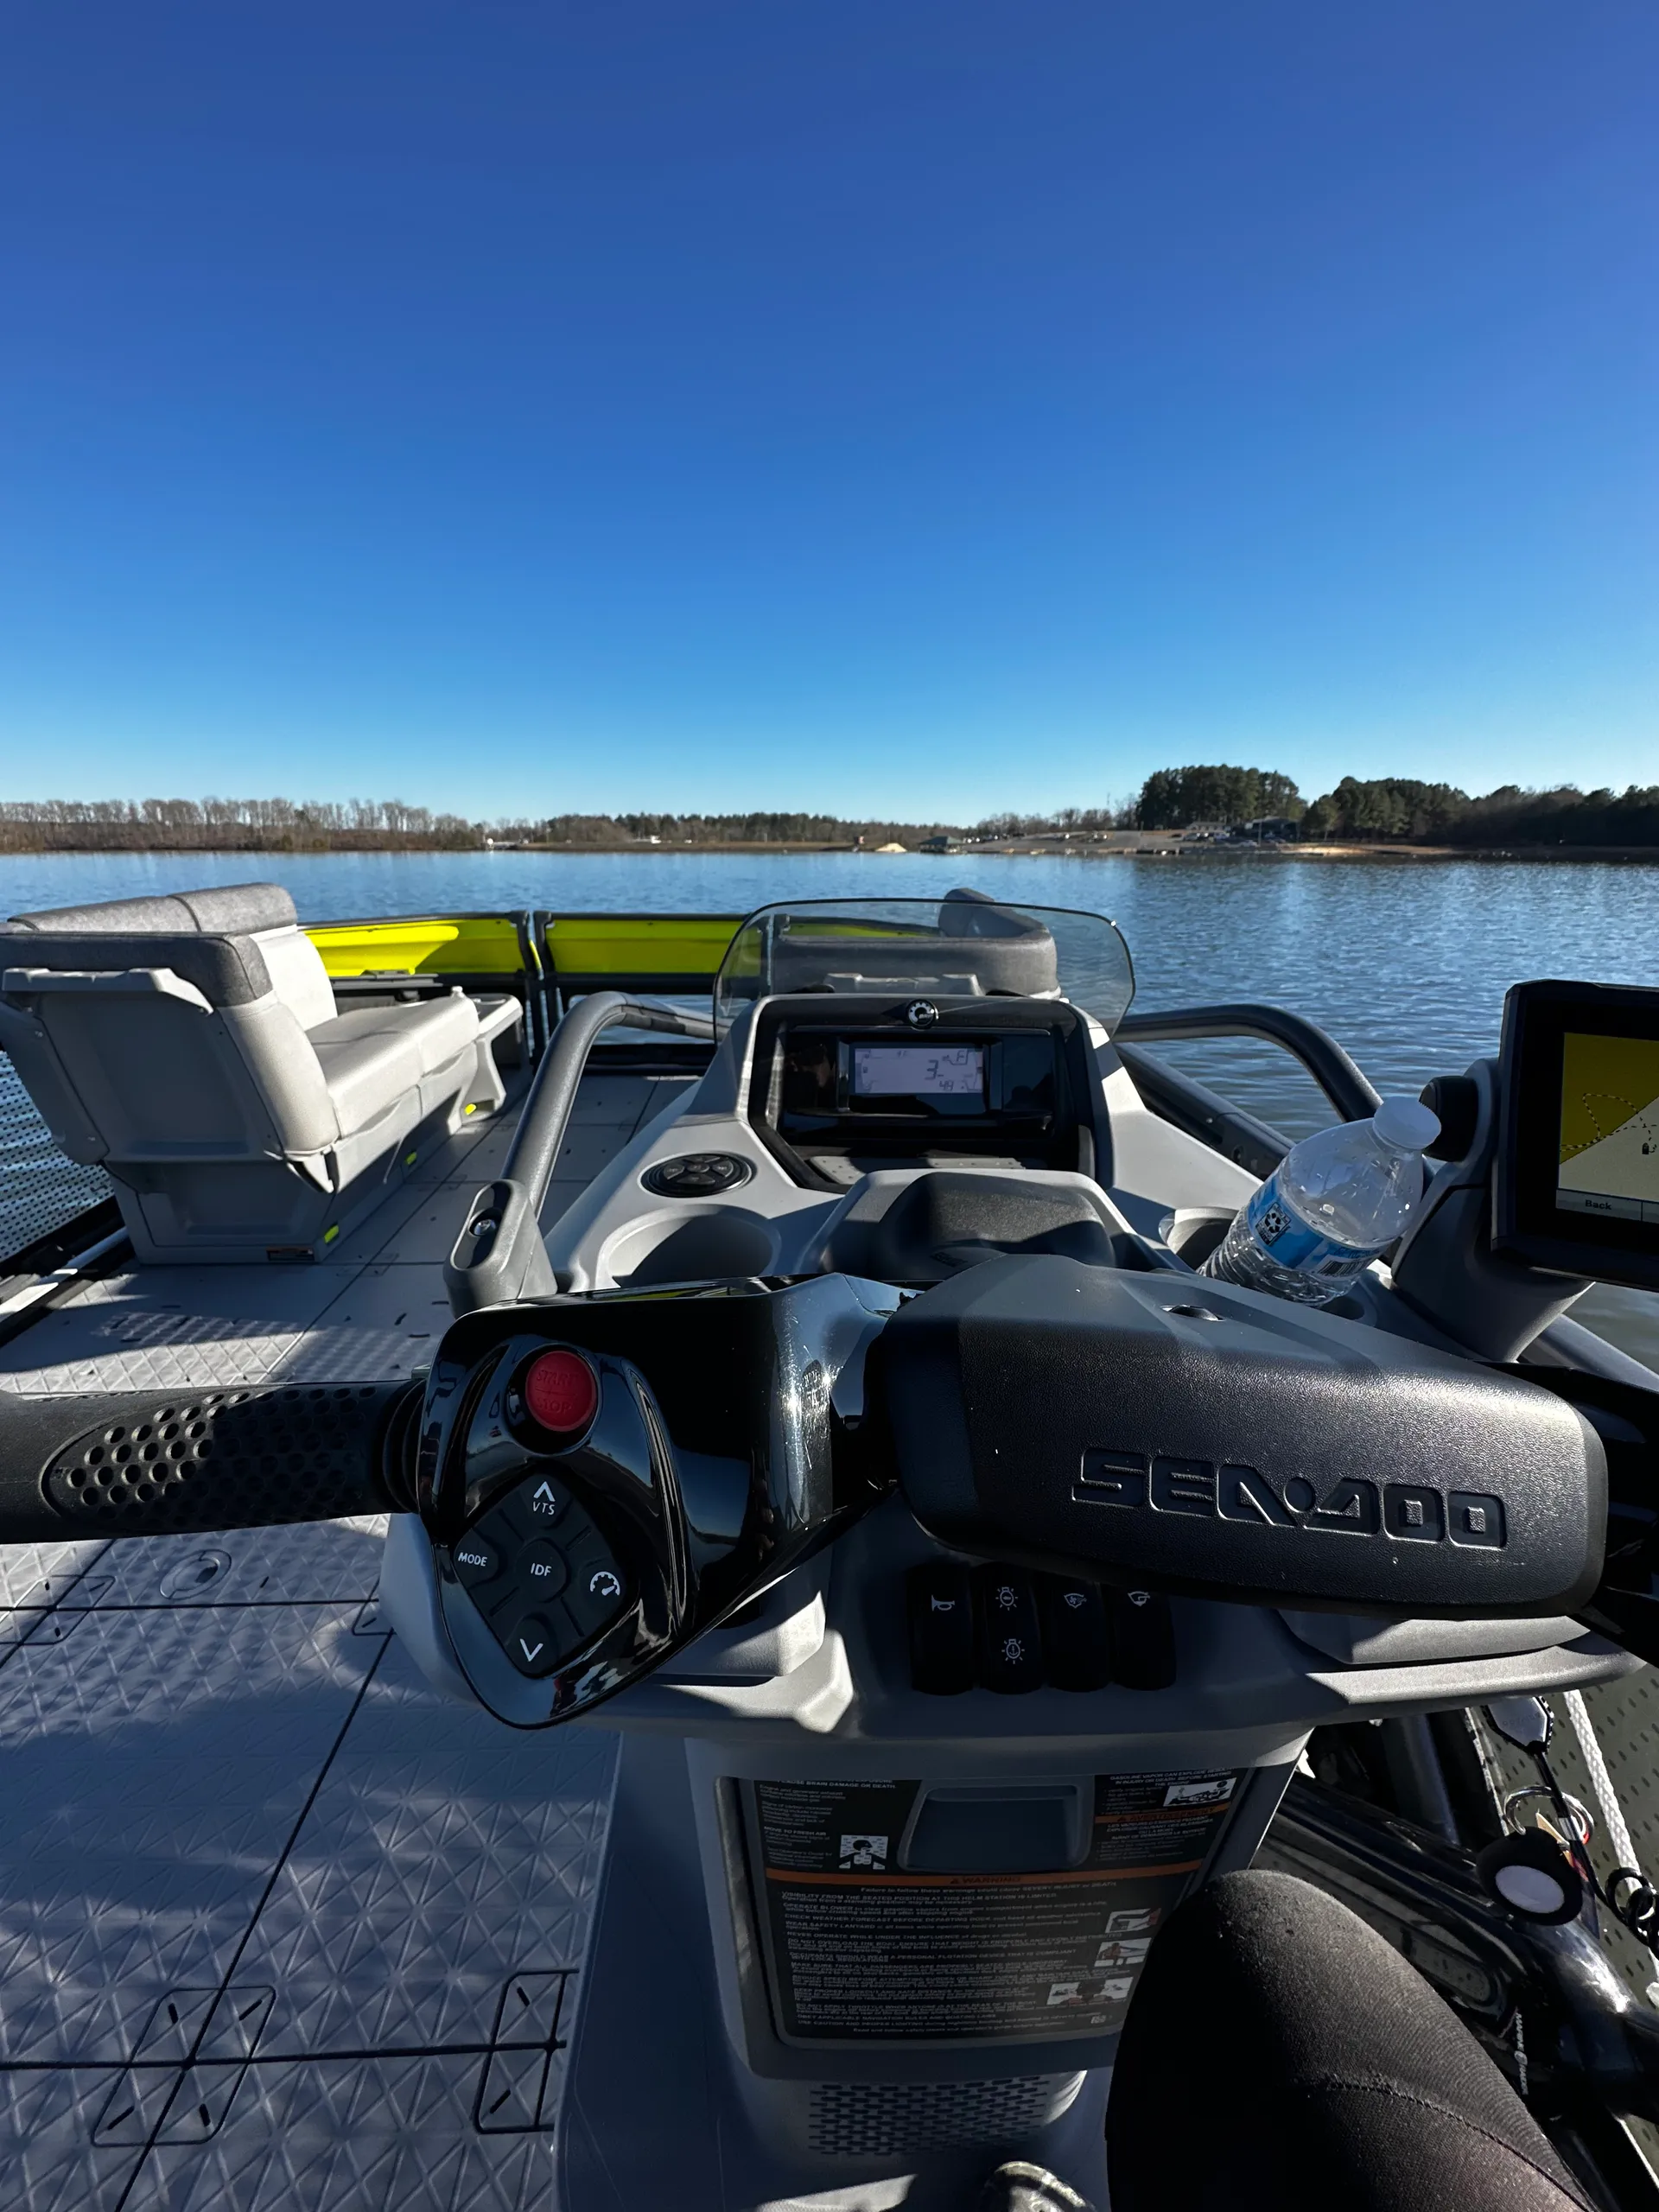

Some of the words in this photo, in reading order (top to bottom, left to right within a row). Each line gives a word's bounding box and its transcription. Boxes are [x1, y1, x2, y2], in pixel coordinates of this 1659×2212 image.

[1585, 1199, 1612, 1211] Back
[537, 1369, 581, 1386] START
[537, 1397, 572, 1414] STOP
[532, 1502, 555, 1516] VTS
[457, 1552, 487, 1567] MODE
[530, 1562, 552, 1578] IDF
[1516, 2012, 1525, 2052] MARINE
